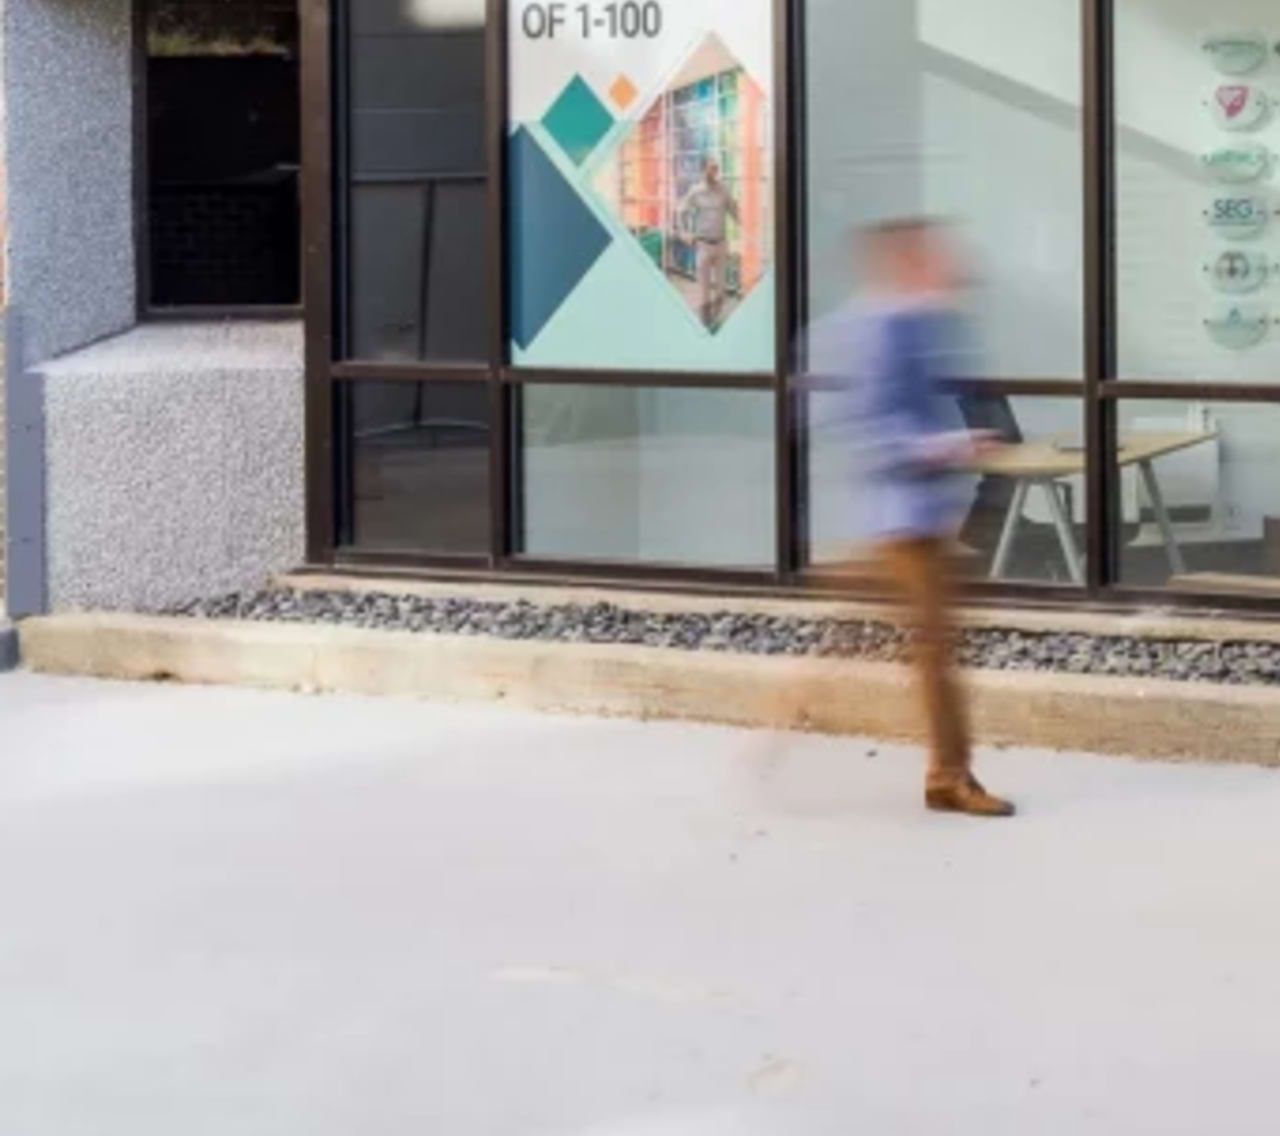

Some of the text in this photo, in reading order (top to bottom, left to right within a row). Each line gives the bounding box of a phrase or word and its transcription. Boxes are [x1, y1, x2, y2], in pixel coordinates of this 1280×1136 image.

[521, 0, 663, 39] OF 1-100
[1212, 198, 1254, 219] SEG
